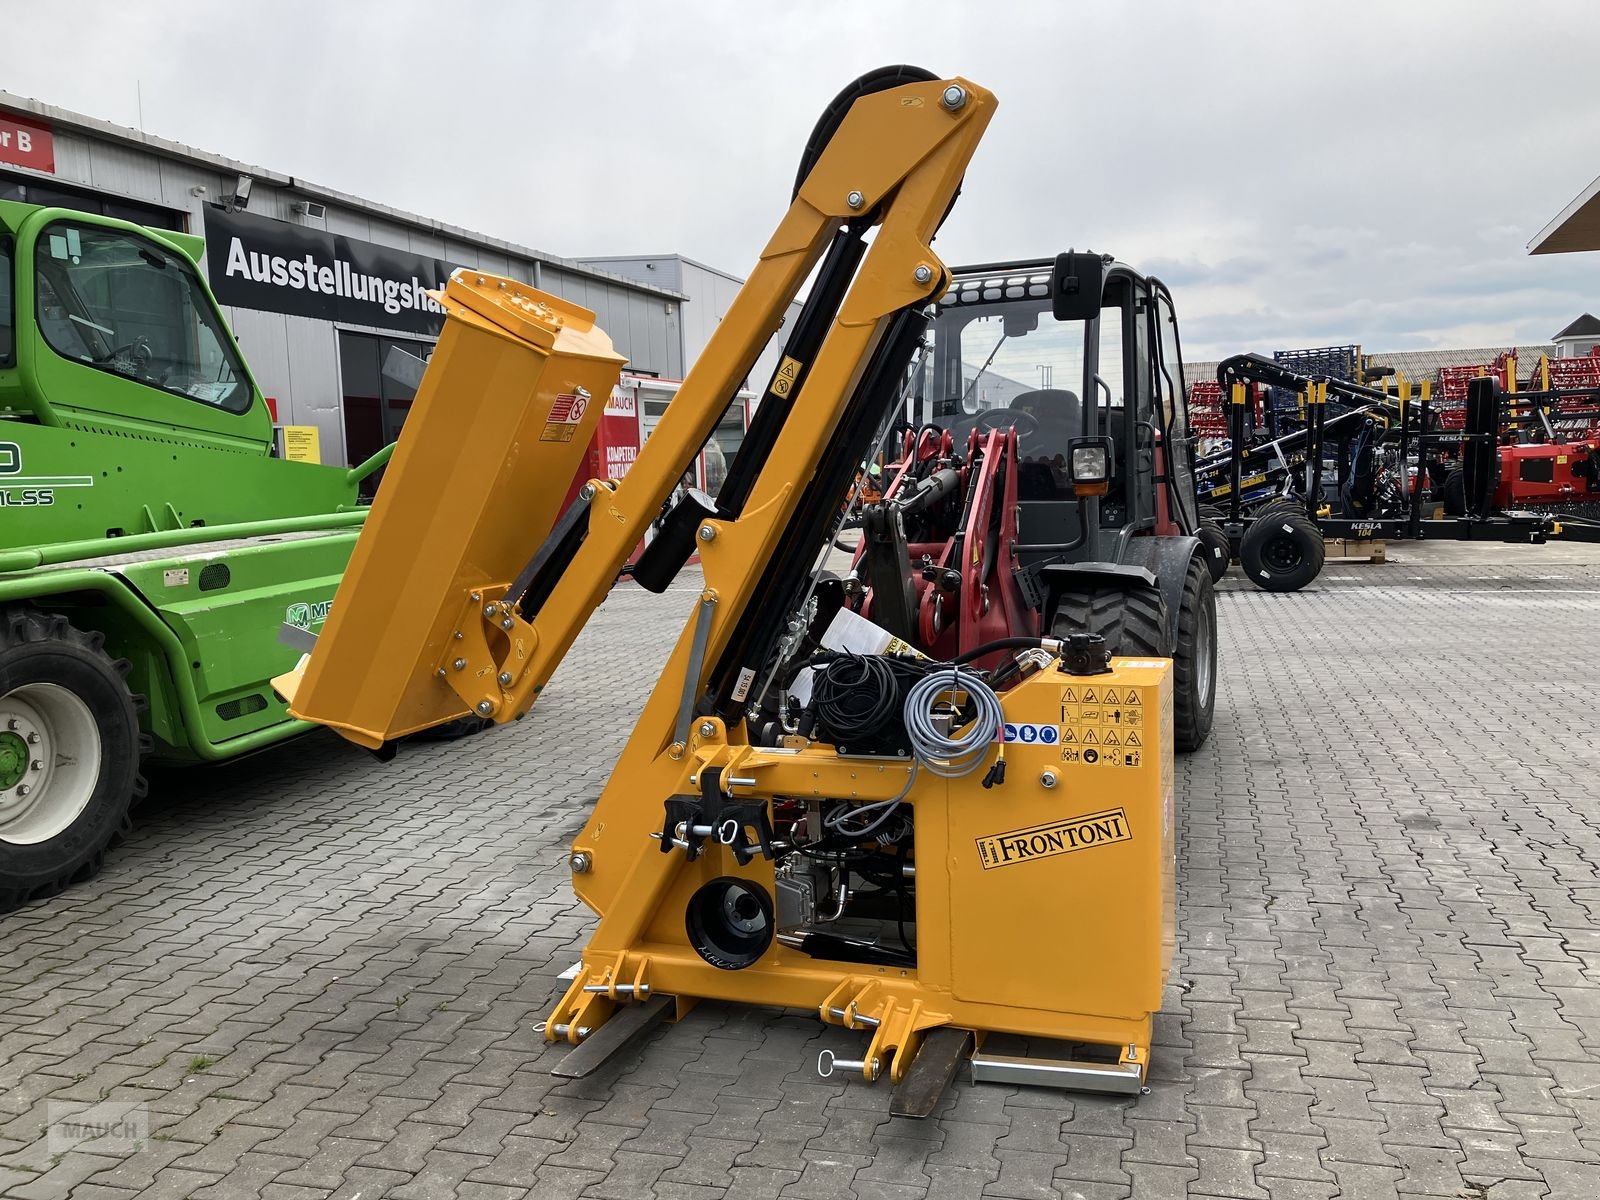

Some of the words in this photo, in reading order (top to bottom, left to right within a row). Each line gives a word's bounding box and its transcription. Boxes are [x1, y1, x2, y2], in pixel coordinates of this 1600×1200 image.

[17, 130, 32, 153] B
[608, 396, 633, 410] MAUCH
[606, 446, 637, 462] KOMPETENZ
[1351, 522, 1382, 530] KESLA
[1358, 529, 1372, 537] 104
[996, 811, 1125, 862] FRONTONI
